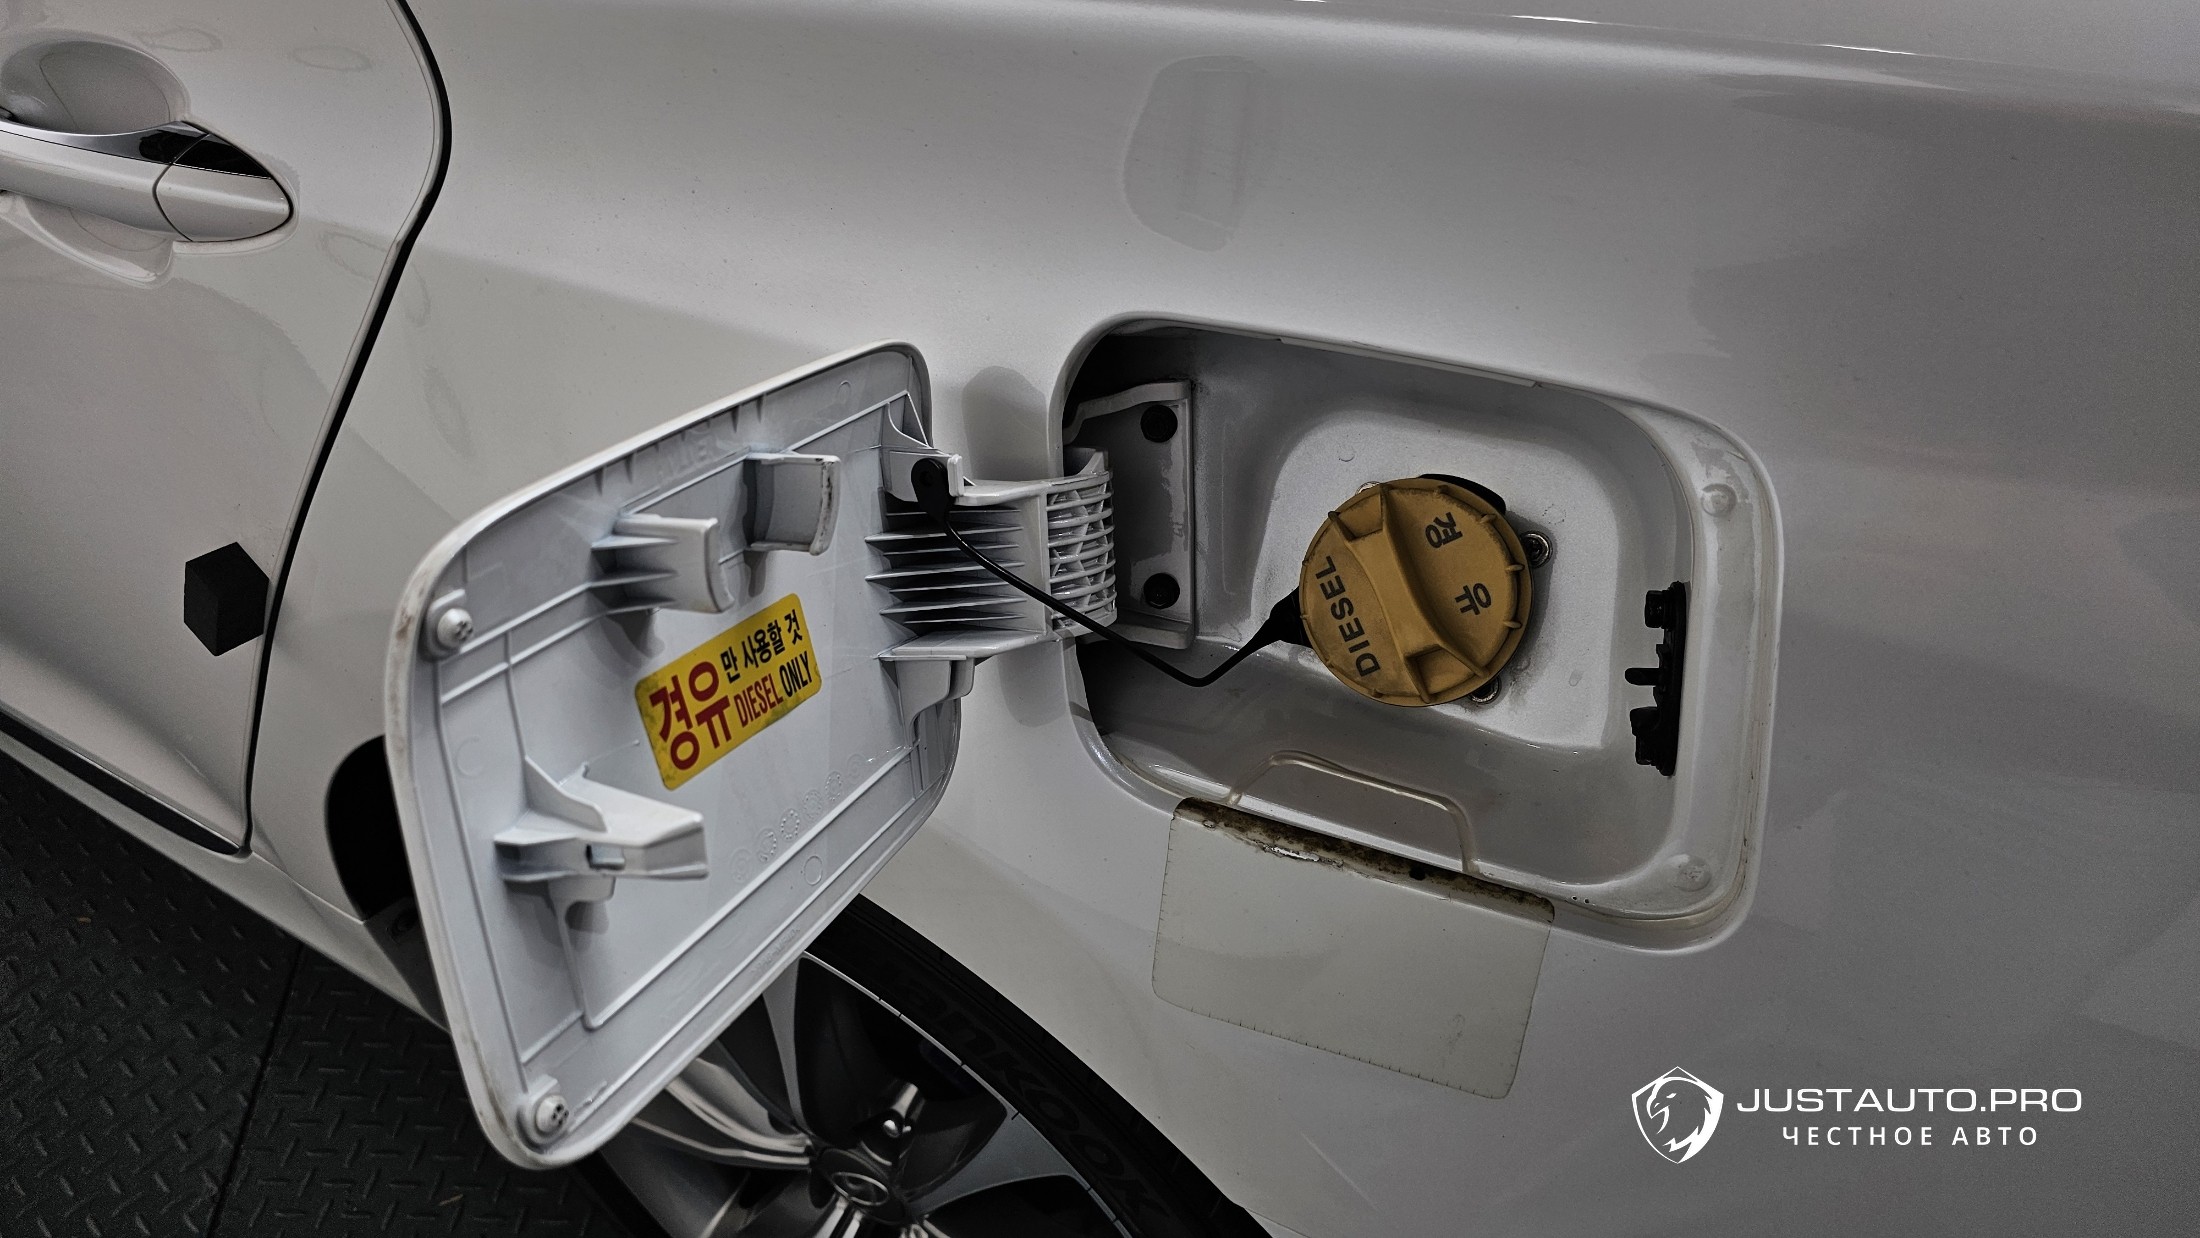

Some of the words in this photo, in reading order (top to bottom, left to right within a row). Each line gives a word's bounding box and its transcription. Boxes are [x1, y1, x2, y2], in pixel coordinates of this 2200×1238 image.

[1315, 555, 1381, 678] DIESEL
[648, 660, 732, 771] 경유
[720, 646, 741, 684] 만
[741, 619, 786, 669] 사용할
[784, 608, 803, 645] 것
[733, 673, 784, 728] DIESEL
[778, 650, 813, 698] ONLY
